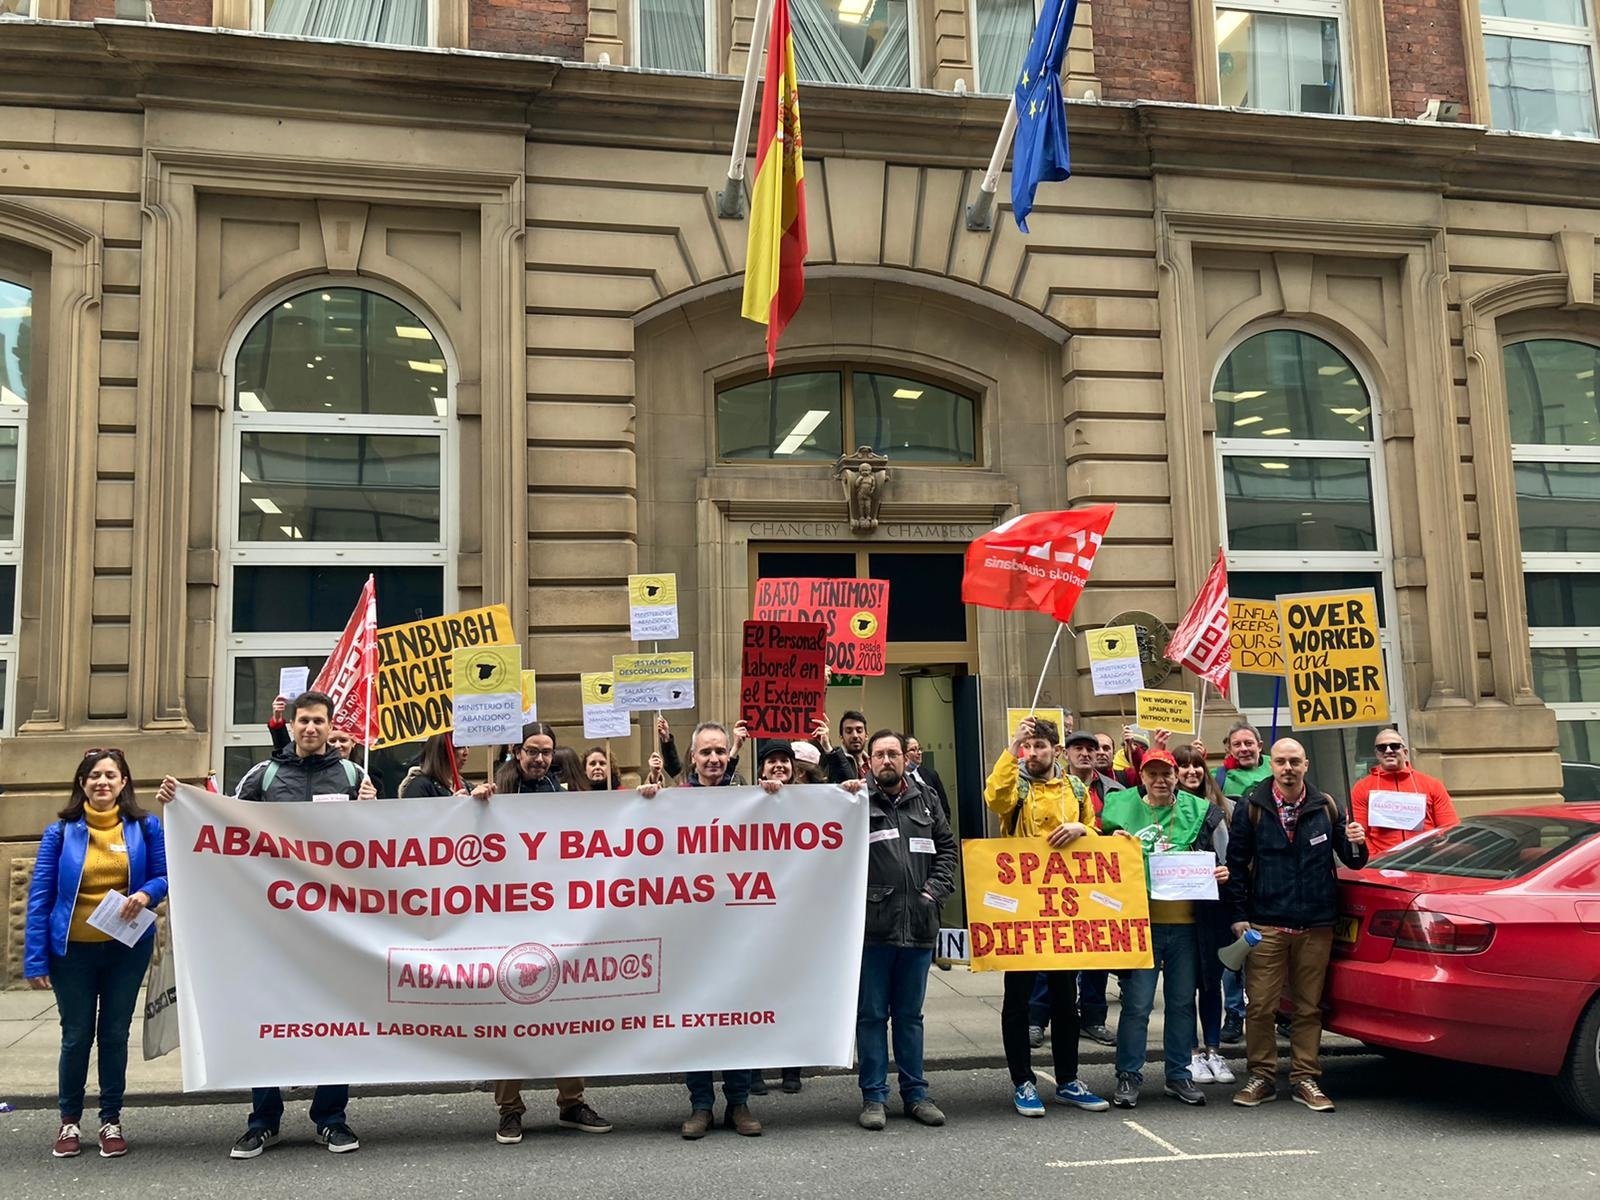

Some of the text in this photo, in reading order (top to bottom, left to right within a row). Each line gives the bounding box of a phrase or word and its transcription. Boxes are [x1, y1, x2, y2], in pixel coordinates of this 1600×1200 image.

[750, 522, 974, 538] CHANCERY CHAMBERS
[758, 578, 884, 608] ¡BAJO MÍNIMOS!
[1232, 604, 1279, 621] INFLA
[1288, 600, 1366, 630] OVER
[743, 624, 826, 650] El Personal
[1231, 620, 1274, 633] KEEPS
[1229, 634, 1265, 650] OUR
[1289, 627, 1375, 654] WORKED
[743, 650, 819, 679] Laboral en
[826, 642, 856, 669] DOS
[856, 653, 883, 671] 2008
[1293, 651, 1330, 671] and
[743, 680, 822, 706] el Exterior
[1294, 666, 1380, 698] UNDER
[374, 693, 453, 746] ONDON
[457, 702, 516, 712] MINISTERIO DE
[462, 713, 511, 722] ABANDONO
[743, 705, 817, 734] EXISTE
[1141, 714, 1170, 722] WITHOUT
[1297, 696, 1357, 723] PAID
[467, 724, 506, 733] EXTERIOR
[193, 819, 843, 870] ABANDONAD@S Y BAJO MÍNIMOS
[996, 851, 1122, 884] SPAIN
[267, 872, 776, 917] CONDICIONES DIGNAS YA
[1038, 887, 1080, 917] IS
[938, 931, 964, 959] IN
[970, 918, 1149, 957] DIFFERENT
[260, 1010, 776, 1039] PERSONAL LABORAL SIN CONVENIO EN EL EXTERIOR
